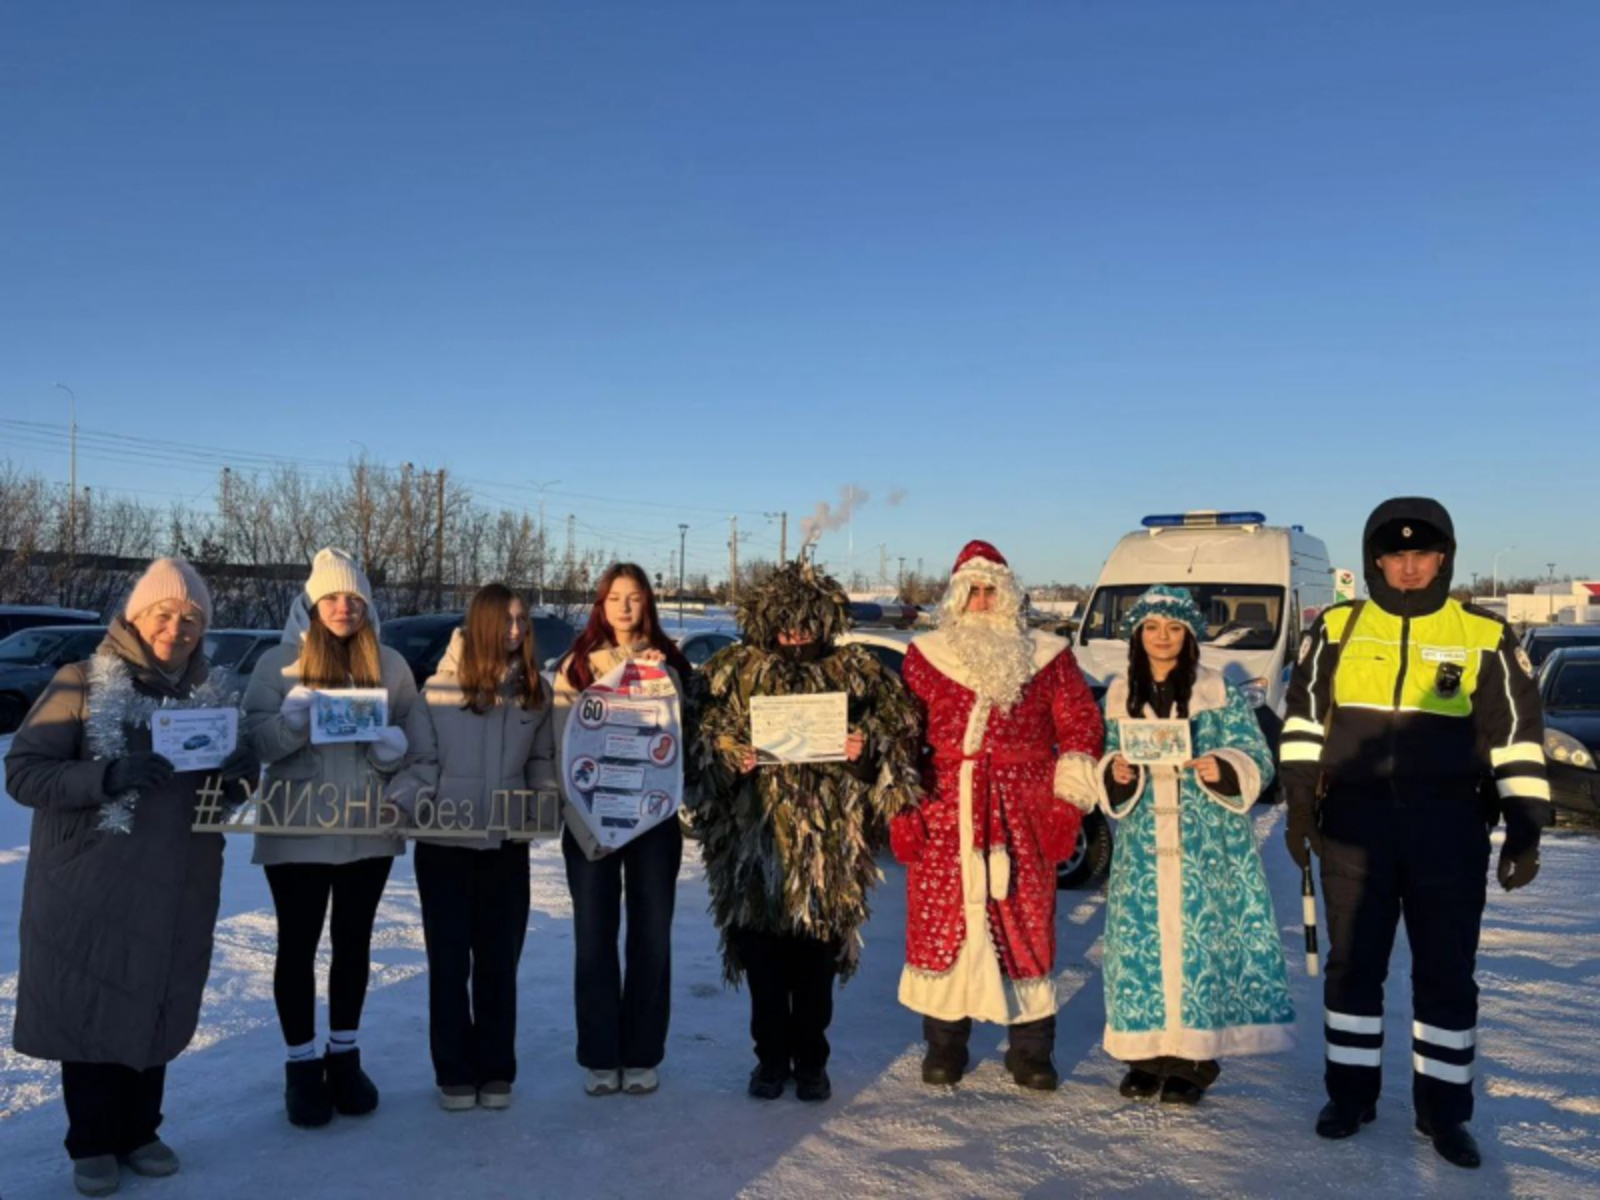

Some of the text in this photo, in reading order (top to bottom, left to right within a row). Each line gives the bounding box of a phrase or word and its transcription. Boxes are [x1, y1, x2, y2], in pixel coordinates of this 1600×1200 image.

[583, 699, 603, 721] 60
[415, 786, 474, 829] без
[486, 789, 560, 836] ДТП
